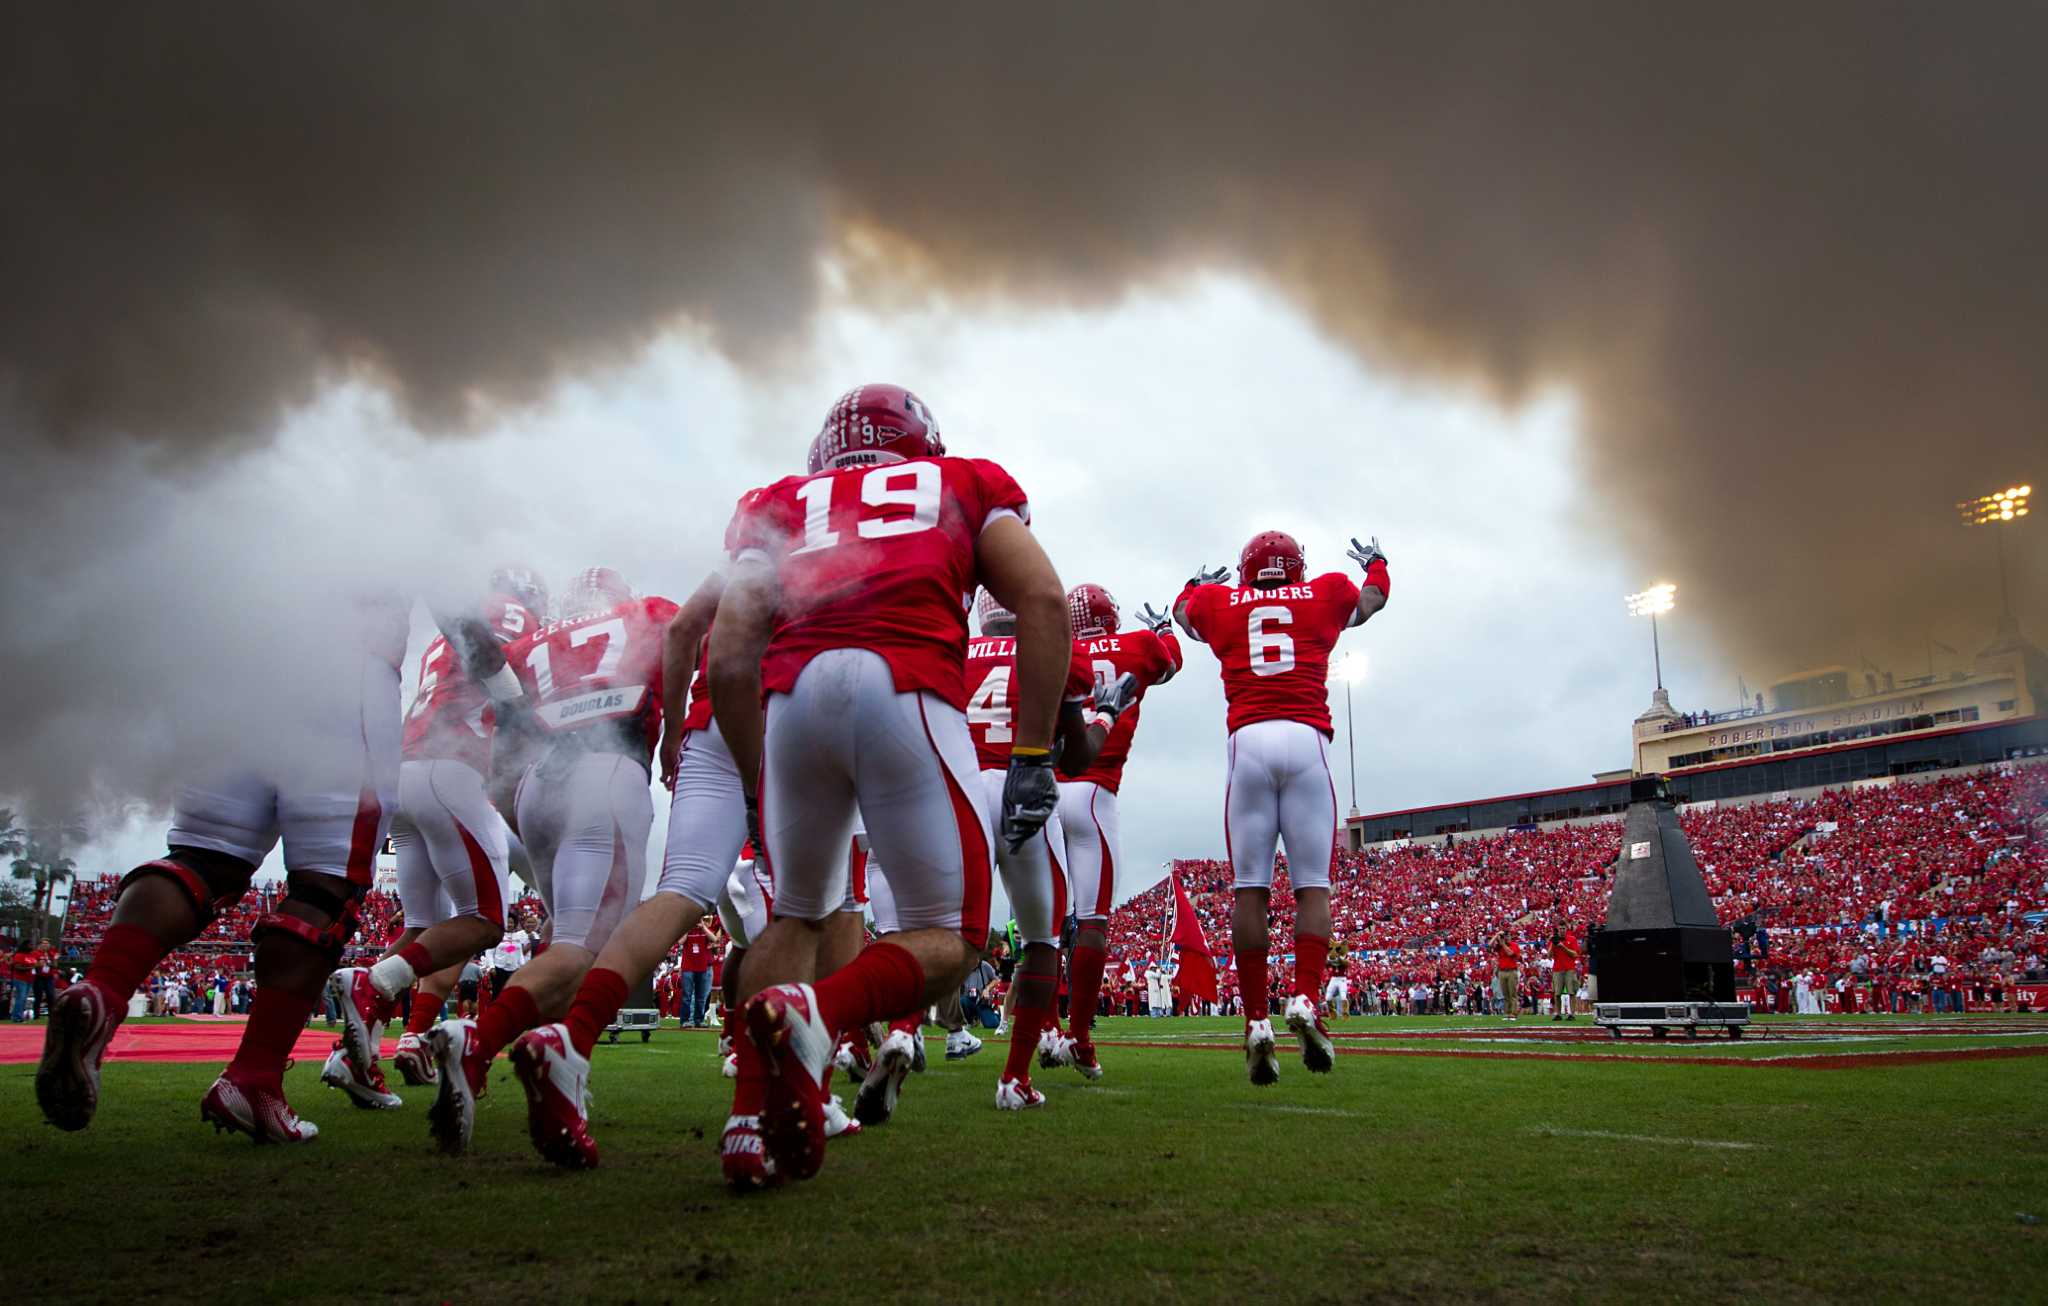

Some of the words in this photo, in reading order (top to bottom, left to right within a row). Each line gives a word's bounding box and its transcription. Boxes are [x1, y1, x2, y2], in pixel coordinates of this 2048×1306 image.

[836, 454, 877, 467] COUGARS
[789, 461, 942, 557] 19
[1276, 556, 1285, 569] 6
[1230, 585, 1315, 606] SANDERS
[1081, 638, 1121, 654] ACE
[1248, 605, 1296, 677] 6
[526, 618, 628, 701] 17
[560, 694, 624, 718] DOUGLAS
[966, 665, 1013, 743] 4
[1708, 719, 1817, 747] ROBERTSON
[1832, 701, 1925, 726] STADIUM
